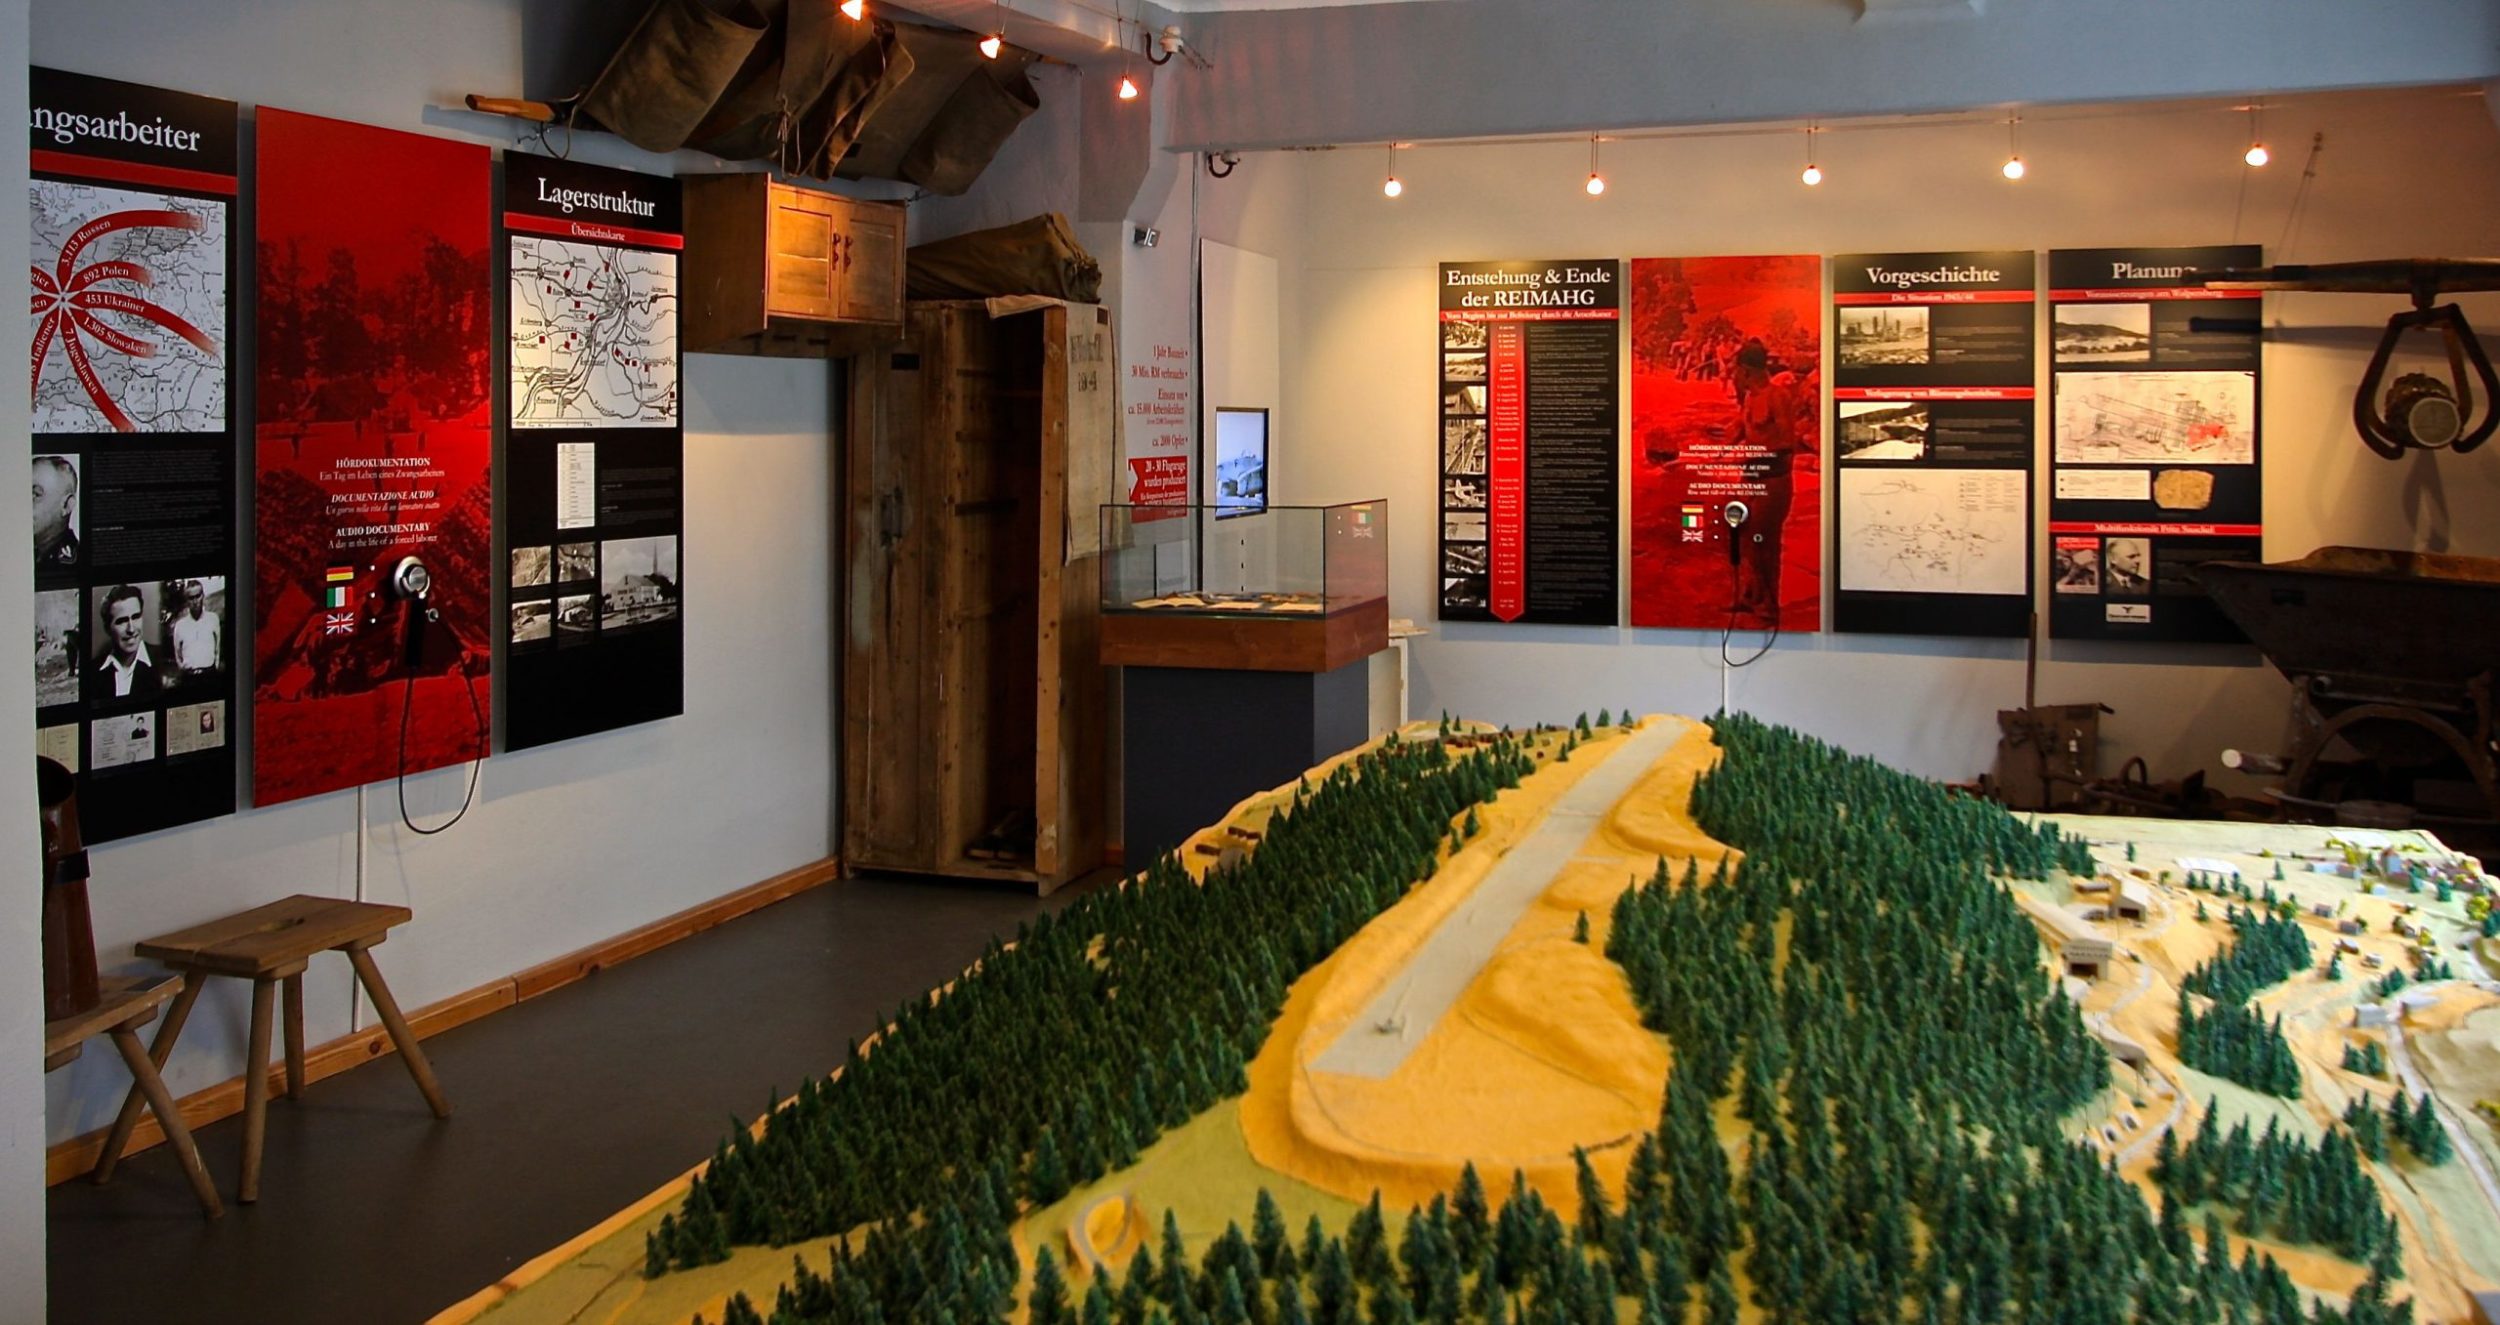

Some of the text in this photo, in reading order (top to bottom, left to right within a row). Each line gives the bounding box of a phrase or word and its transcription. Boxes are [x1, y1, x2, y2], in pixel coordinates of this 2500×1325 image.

[30, 106, 201, 152] ngsarbeiter
[538, 177, 655, 217] Lagerstruktur
[78, 220, 111, 242] Russen
[102, 266, 129, 276] Polen
[1447, 267, 1610, 289] Entstehung & Ende
[1866, 266, 2000, 288] Vorgeschichte
[2112, 263, 2197, 279] Planun
[85, 294, 144, 312] 453 Ukrainer
[1461, 289, 1595, 306] der REIMAHG
[84, 317, 147, 354] 1.305 Slowaken
[66, 338, 99, 395] Jugoslawen
[336, 457, 431, 469] HÖRDOKUMENTATION
[357, 470, 377, 479] Leben
[331, 490, 435, 503] DOCUMENTAZIONE AUDIO
[336, 522, 430, 537] AUDIO DOCUMENTARY
